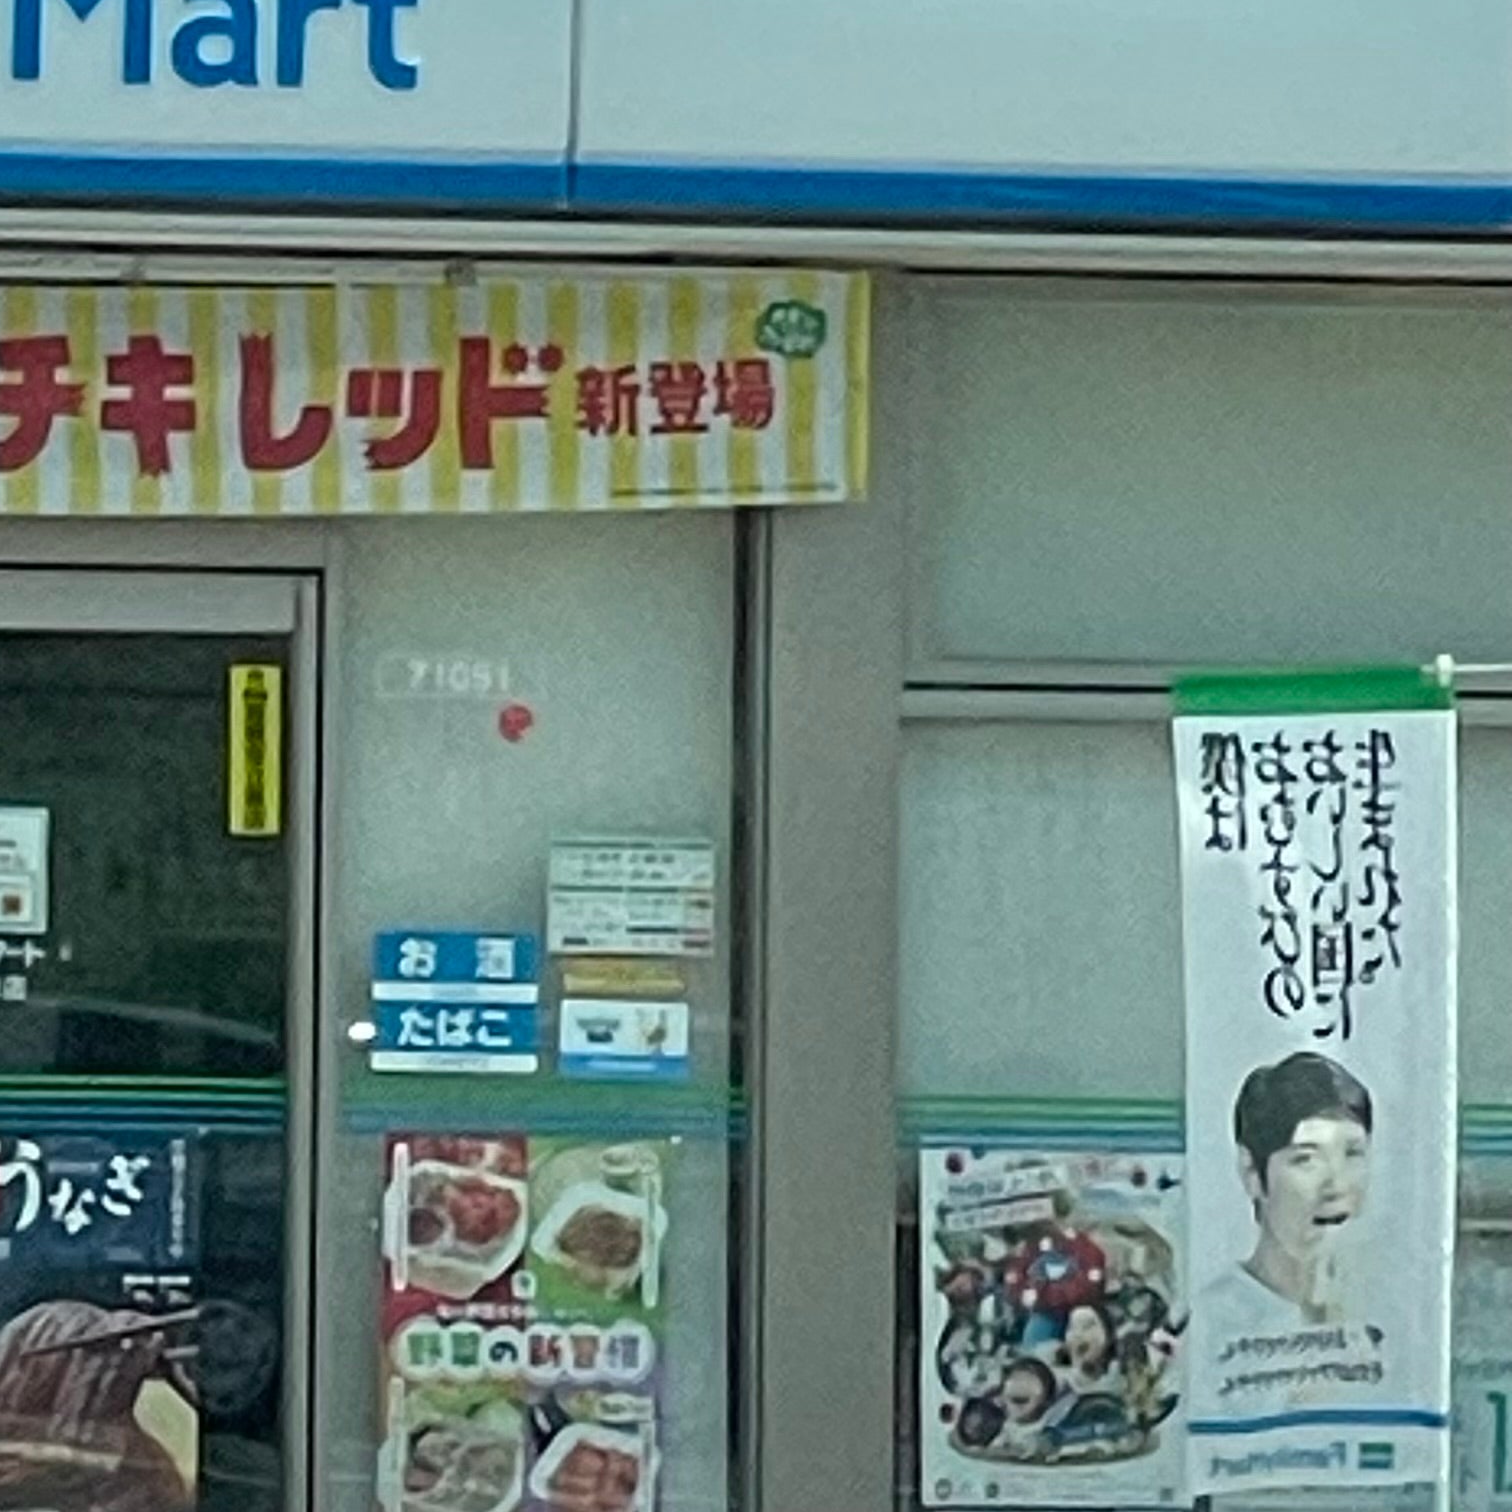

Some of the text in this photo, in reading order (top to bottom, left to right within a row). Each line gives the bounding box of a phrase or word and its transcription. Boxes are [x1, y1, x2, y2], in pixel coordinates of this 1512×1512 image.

[574, 357, 774, 437] 新登場
[397, 1007, 512, 1046] たばこ
